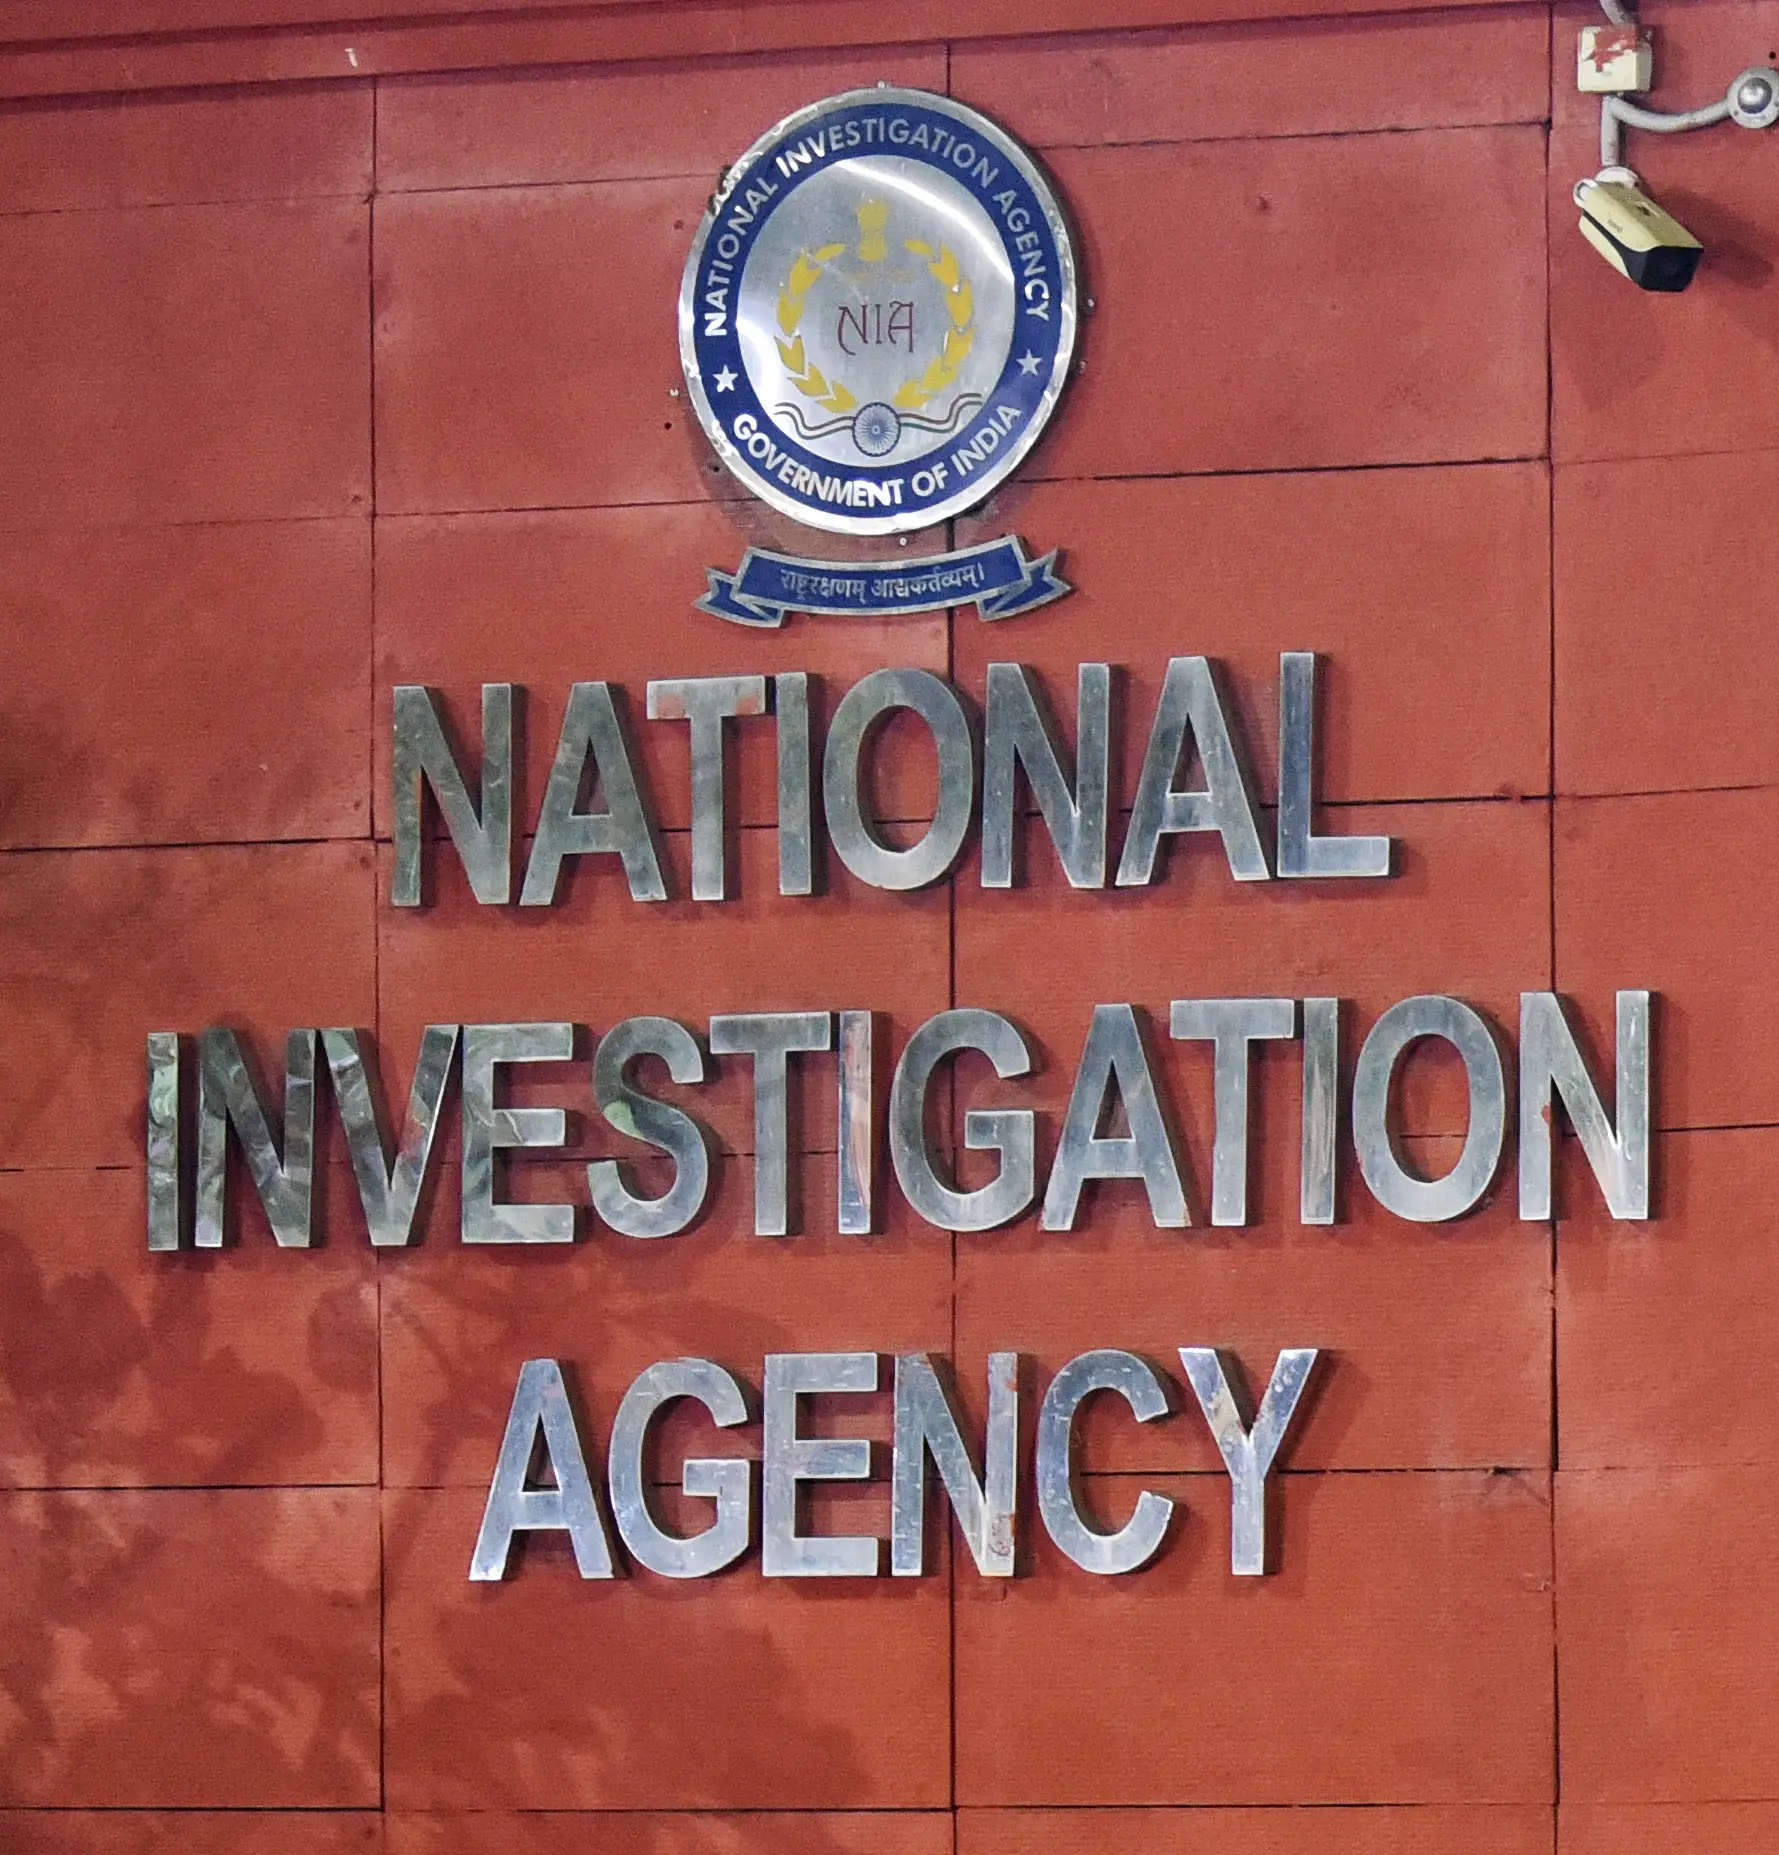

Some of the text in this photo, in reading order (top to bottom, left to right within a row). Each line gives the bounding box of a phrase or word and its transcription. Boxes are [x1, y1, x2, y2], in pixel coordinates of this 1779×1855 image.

[704, 118, 1050, 337] NATIONAL INVESTIGATION AGENCY
[836, 301, 914, 355] NIA
[733, 403, 1022, 507] GOVERNMENT OF INDIA
[390, 650, 1391, 907] NATIONAL
[145, 989, 1651, 1252] INVESTIGATION
[467, 1346, 1319, 1582] AGENCY
